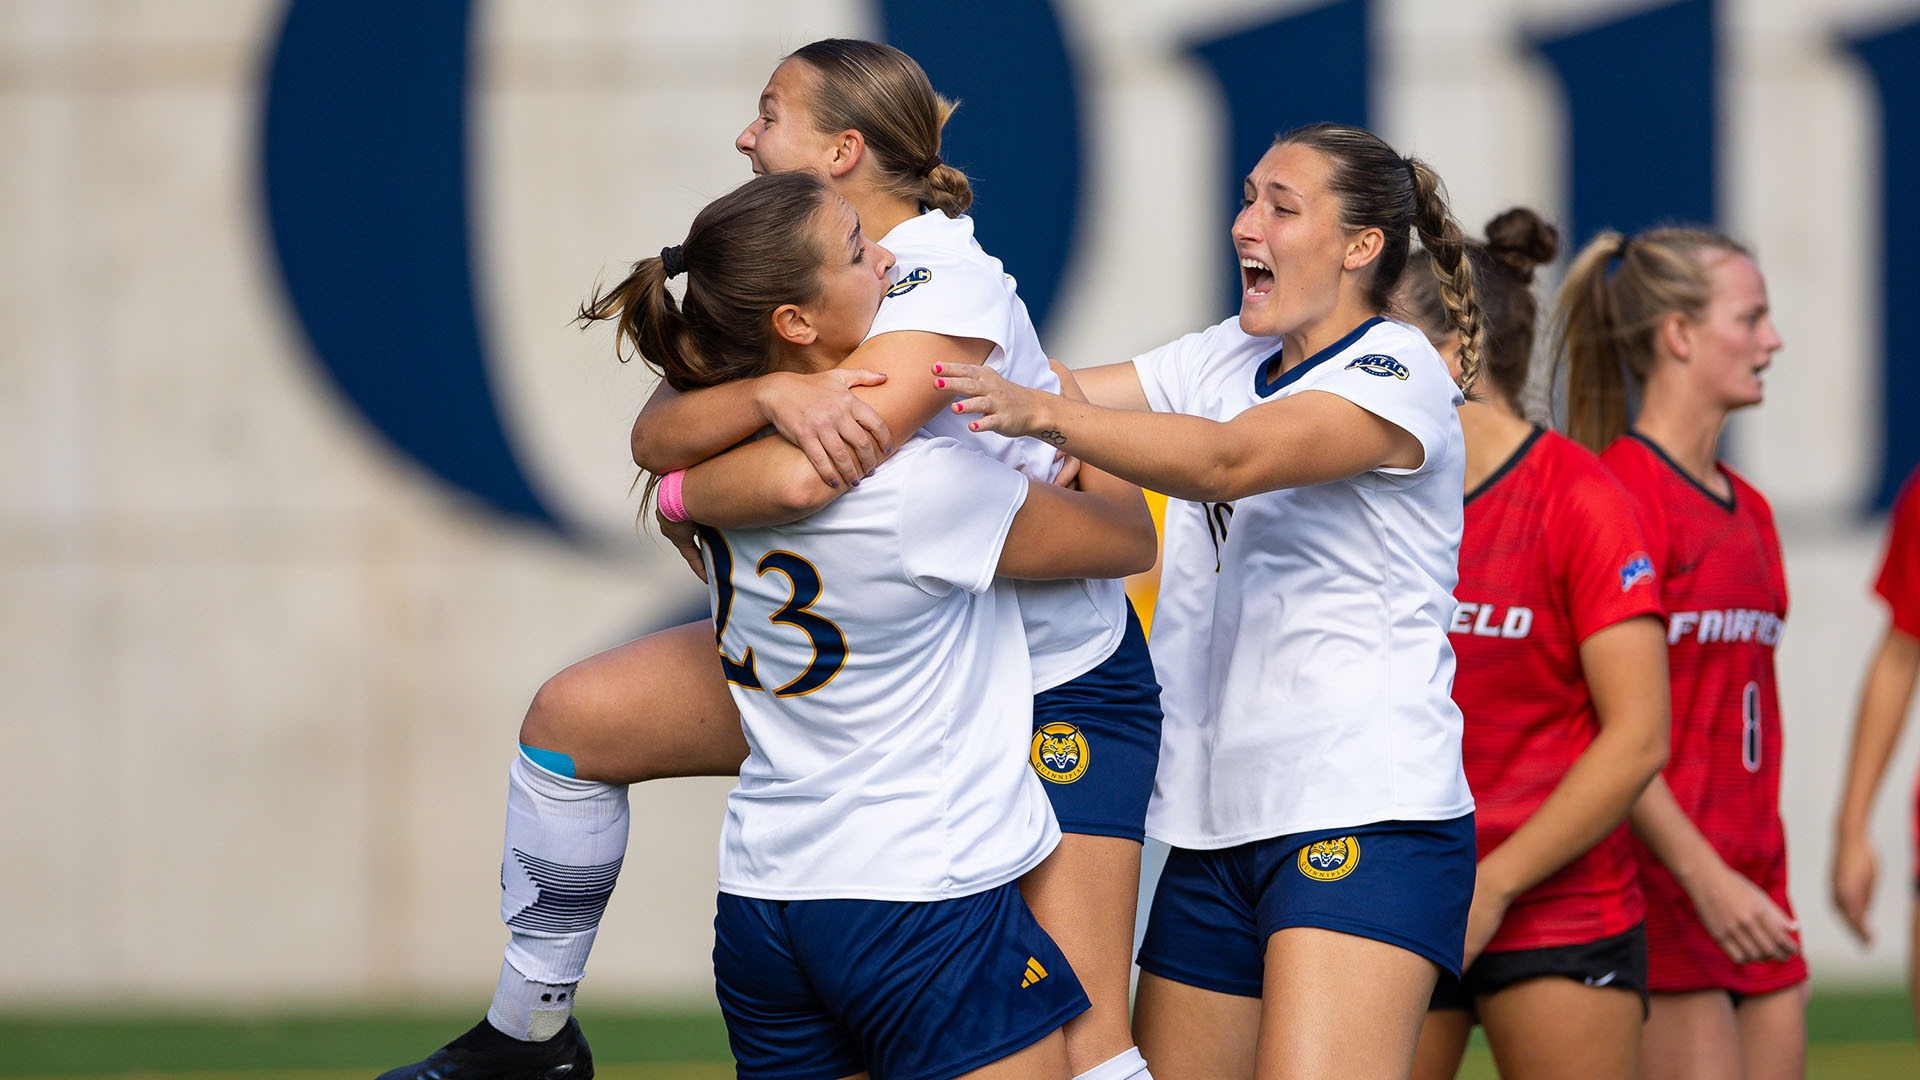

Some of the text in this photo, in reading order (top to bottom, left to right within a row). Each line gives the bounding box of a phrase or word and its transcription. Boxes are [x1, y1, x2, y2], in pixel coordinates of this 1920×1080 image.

[697, 525, 849, 698] 23
[1742, 680, 1761, 773] 8
[1035, 762, 1085, 780] QUINNIPIAC
[1301, 861, 1351, 878] QUINNIPIAC
